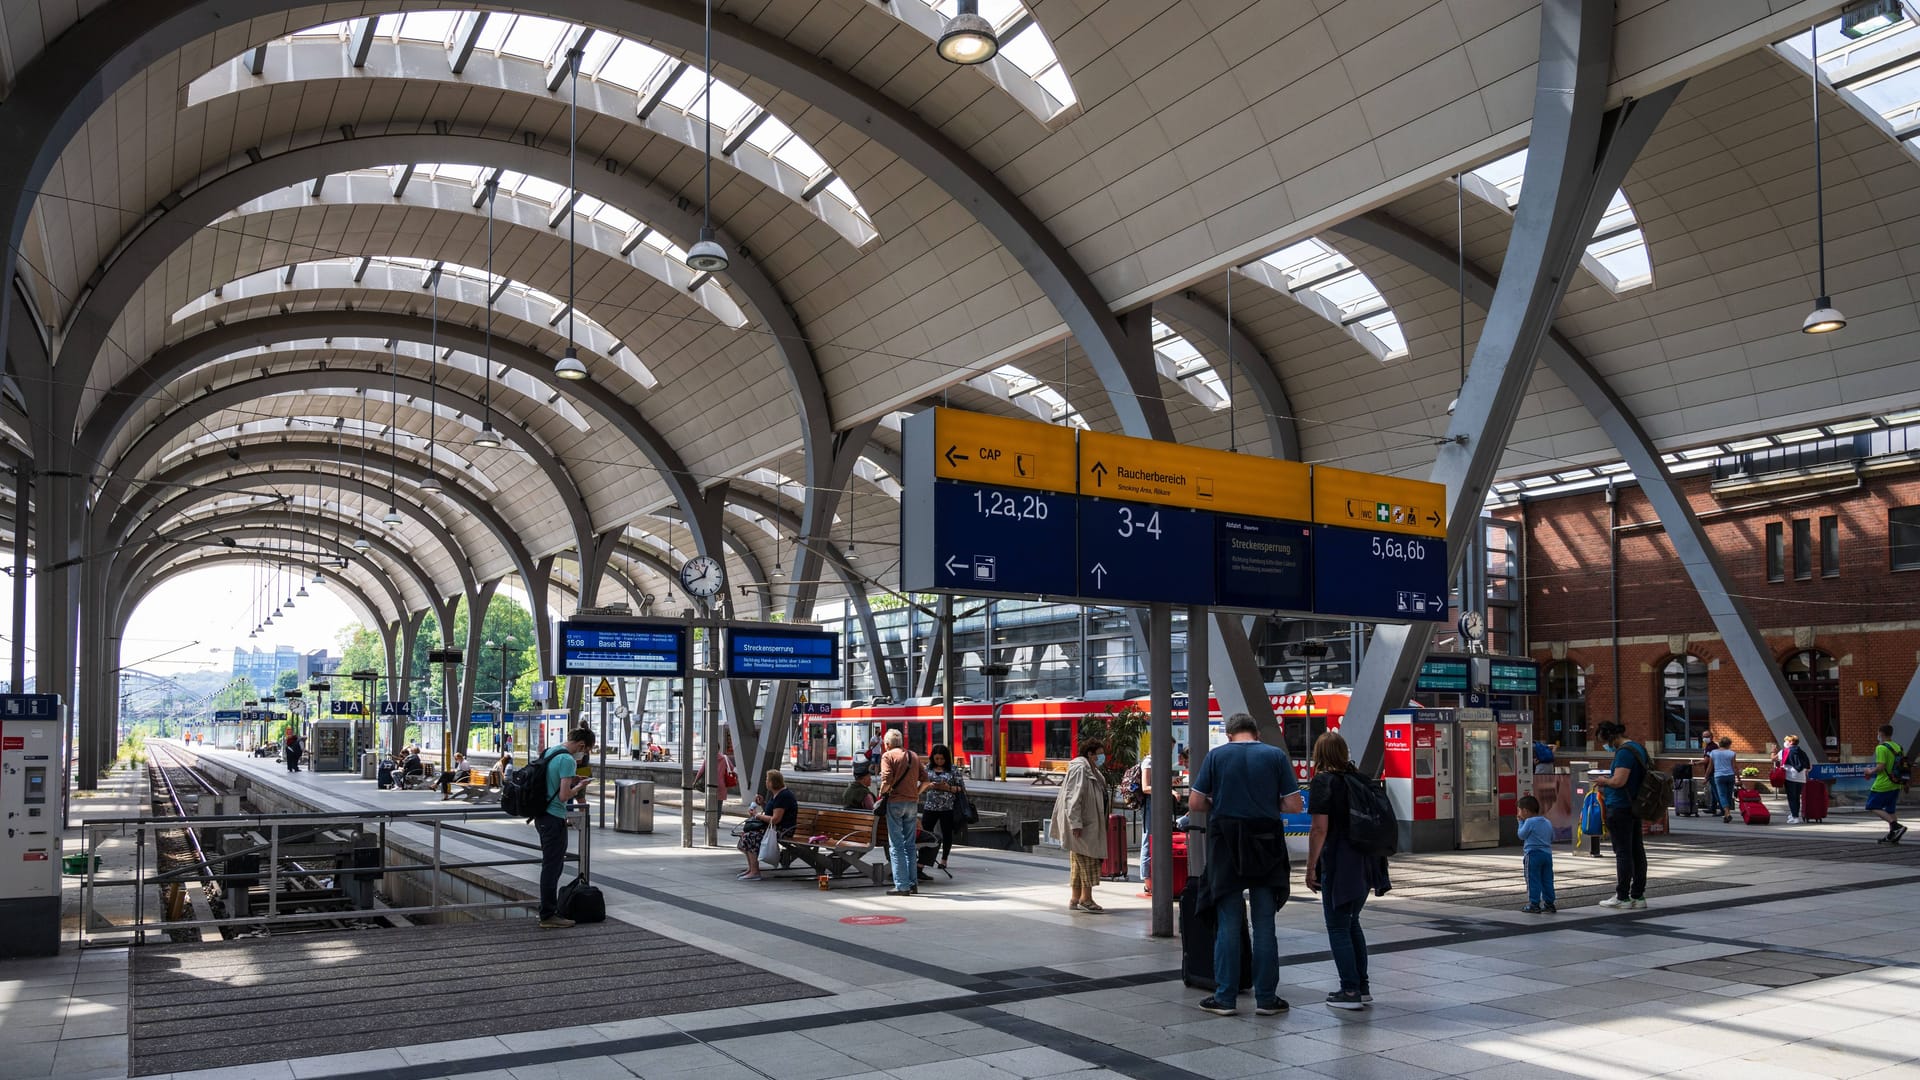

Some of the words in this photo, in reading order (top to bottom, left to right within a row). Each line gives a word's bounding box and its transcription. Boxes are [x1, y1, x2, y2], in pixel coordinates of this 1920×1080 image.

[979, 447, 1001, 461] CAP
[1117, 466, 1186, 486] Raucherbereich
[1118, 484, 1140, 494] Smoking
[973, 489, 1048, 521] 1,2a,2b
[1362, 510, 1373, 519] WC
[1117, 507, 1162, 541] 3-4
[1231, 538, 1291, 556] Streckensperrung
[1372, 536, 1425, 562] 5,6a,6b
[567, 639, 585, 647] 15:08
[599, 640, 617, 648] Basel
[743, 643, 794, 654] Streckensperrung
[1470, 694, 1479, 703] 6b
[333, 702, 341, 712] 3
[349, 702, 359, 712] A
[385, 702, 394, 712] A
[401, 702, 410, 712] 4
[792, 703, 799, 713] A
[807, 703, 815, 713] A
[820, 703, 830, 713] 6a
